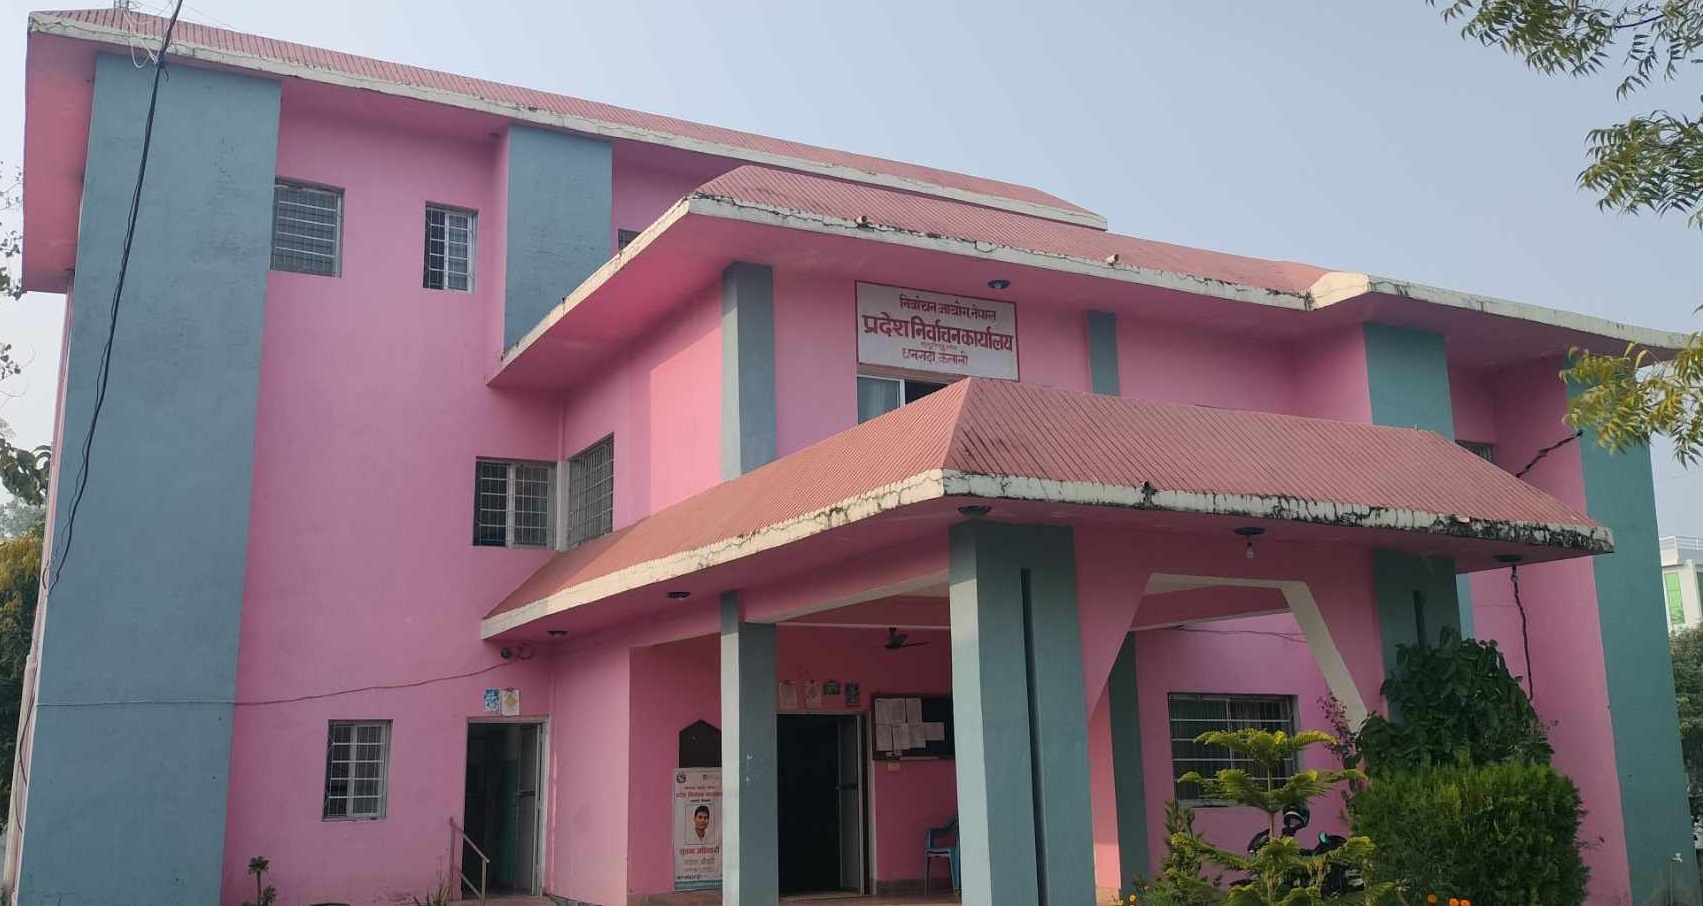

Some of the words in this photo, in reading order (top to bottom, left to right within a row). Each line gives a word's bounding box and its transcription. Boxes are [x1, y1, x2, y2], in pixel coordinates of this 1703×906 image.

[862, 312, 910, 338] प्रदेश
[911, 316, 961, 344] निर्वाचन
[961, 326, 1013, 351] कार्यालय
